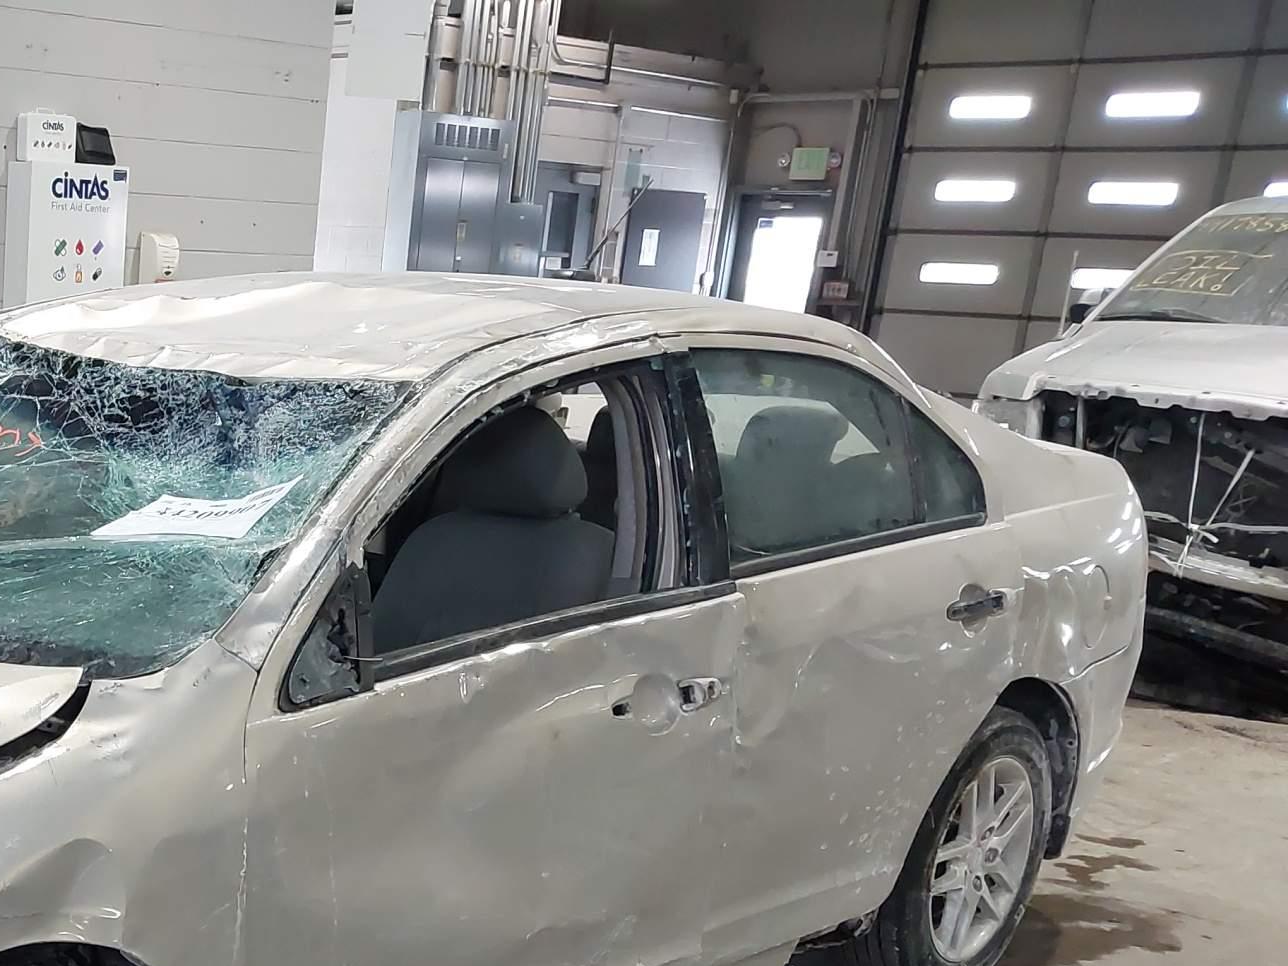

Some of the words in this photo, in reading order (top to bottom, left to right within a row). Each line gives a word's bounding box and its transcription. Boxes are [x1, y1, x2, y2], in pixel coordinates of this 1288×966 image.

[51, 201, 68, 211] First
[69, 202, 83, 212] Aid
[85, 203, 110, 213] Center
